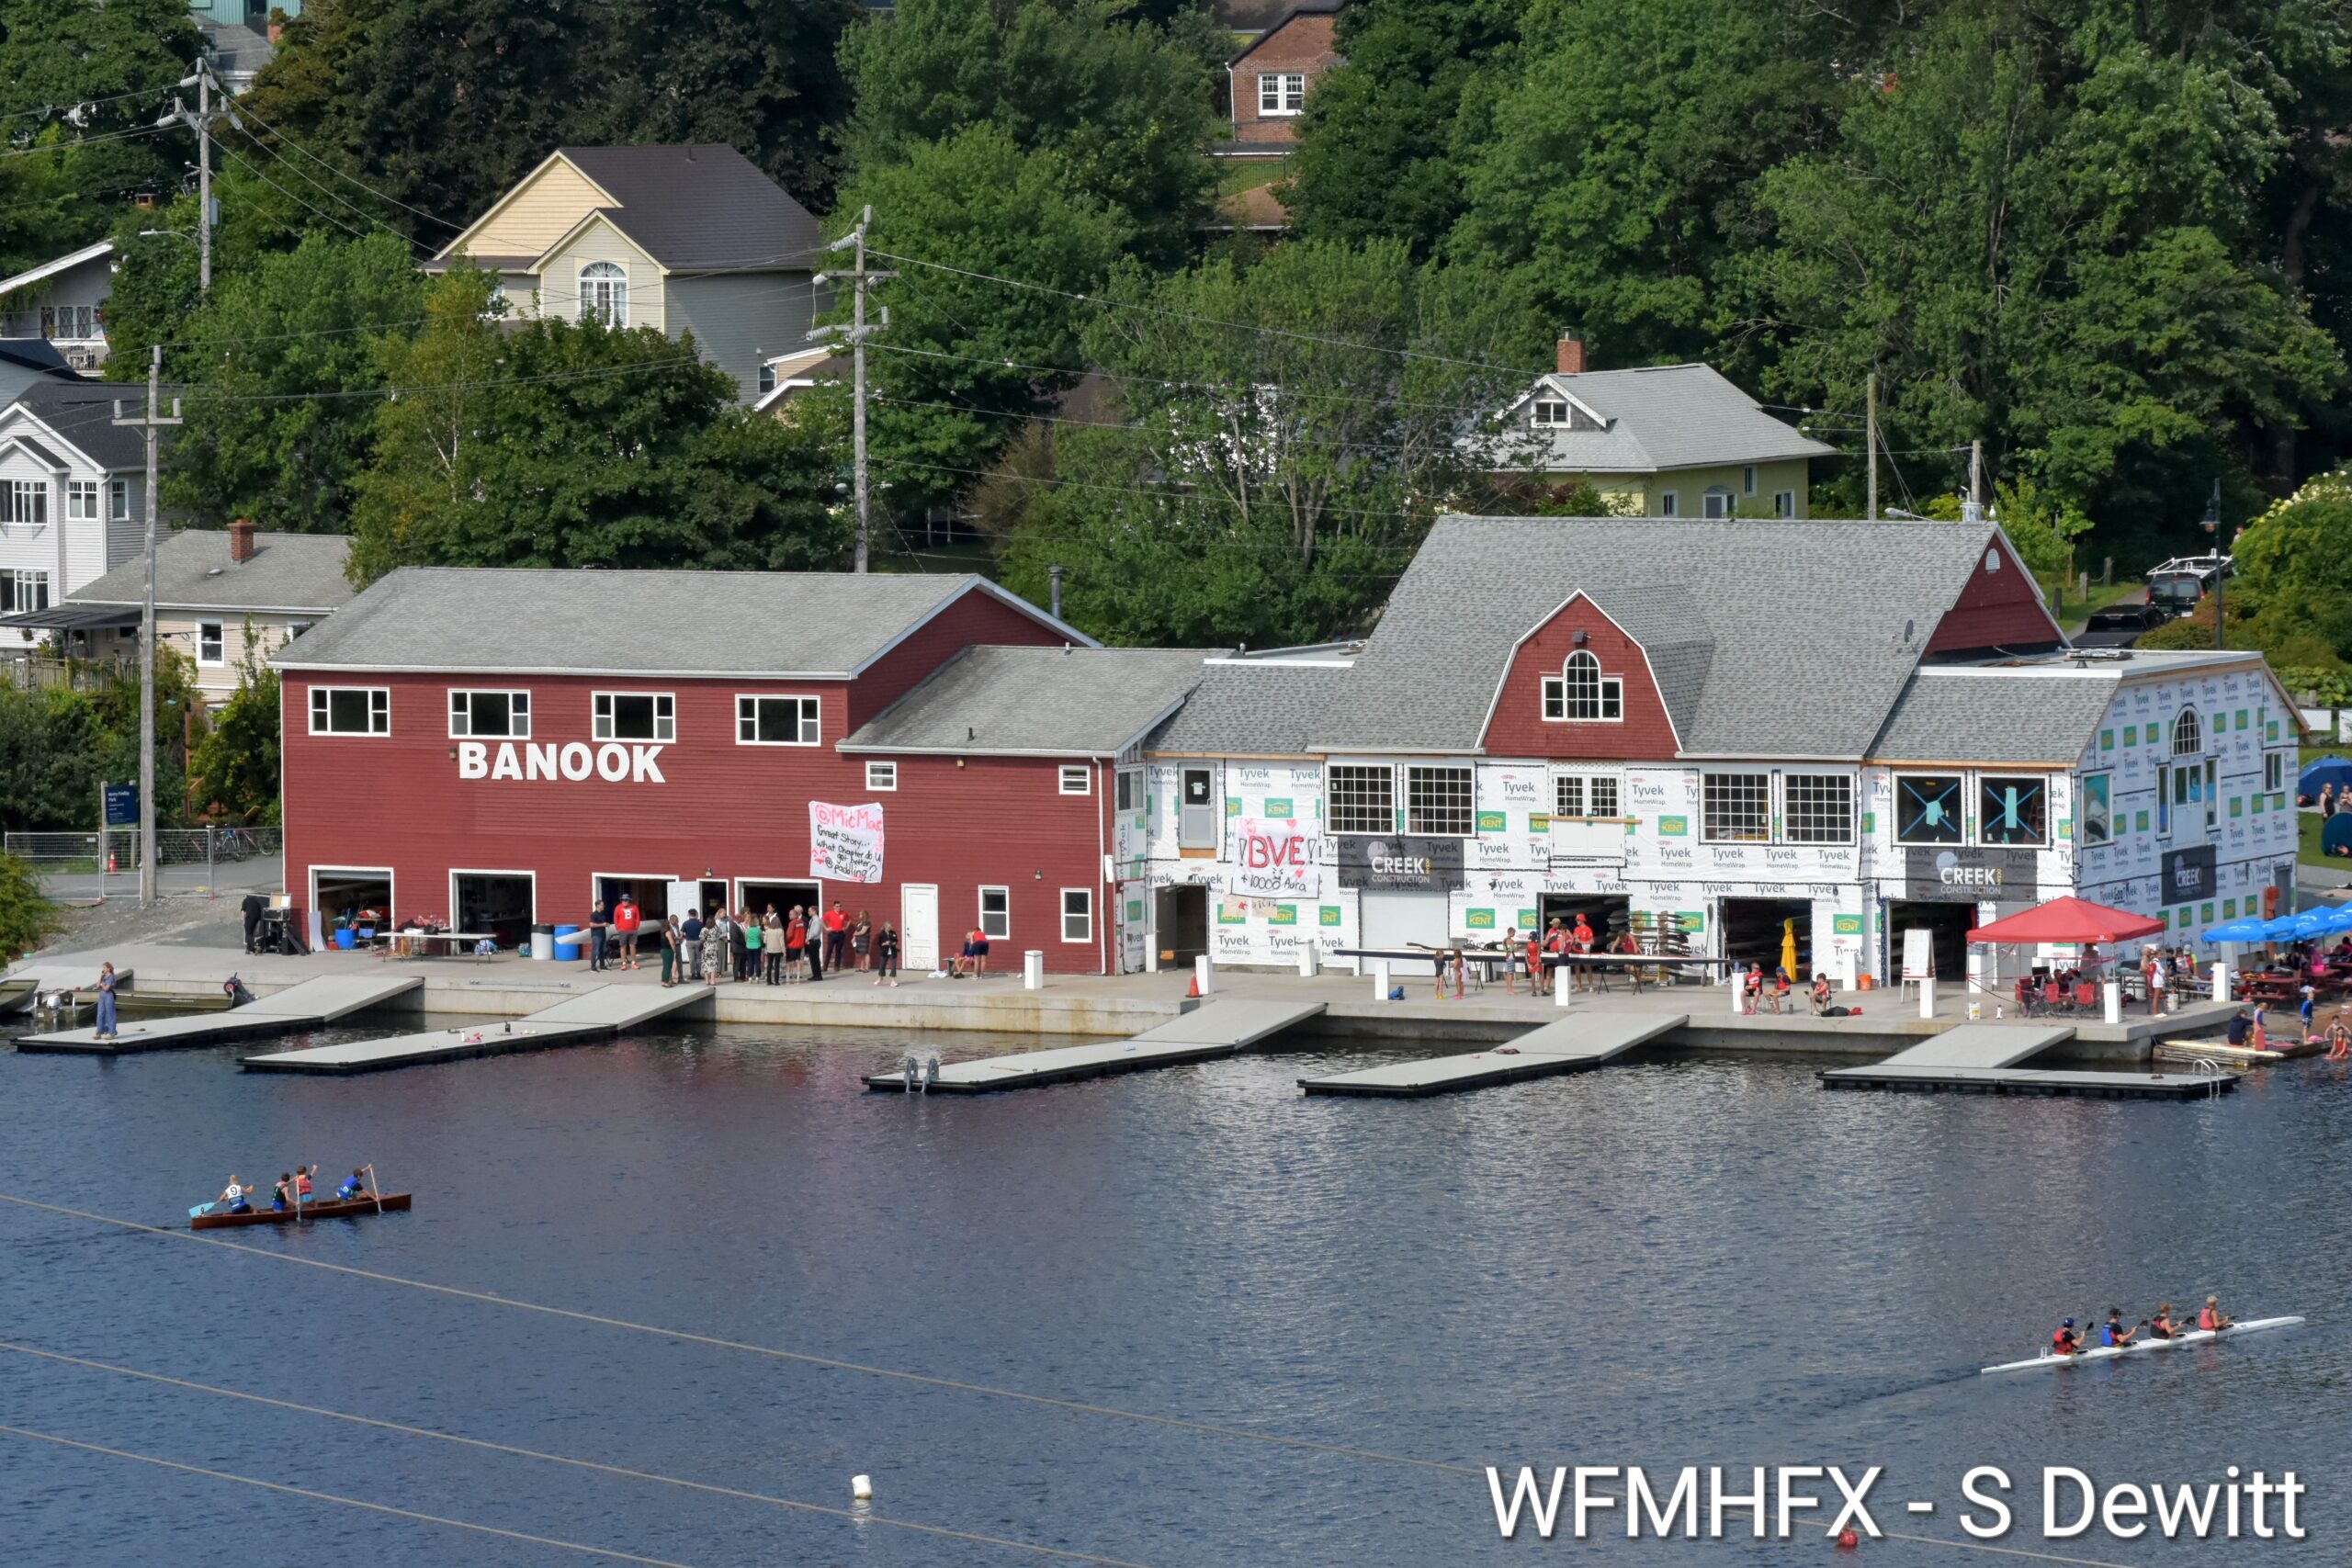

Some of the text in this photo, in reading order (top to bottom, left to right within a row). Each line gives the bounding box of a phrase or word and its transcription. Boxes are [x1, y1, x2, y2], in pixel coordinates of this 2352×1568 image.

[458, 741, 667, 784] BANOOK
[1238, 767, 1270, 780] Tyvek
[1289, 768, 1320, 781] Tyvek
[1503, 781, 1535, 795] Tyvek
[1632, 784, 1664, 797] Tyvek
[1872, 782, 1892, 795] Tyv
[1482, 819, 1501, 829] KENT
[1477, 842, 1510, 855] Tyvek
[1530, 843, 1549, 856] Tyv
[1659, 847, 1691, 860] Tyvek
[1712, 847, 1744, 861] Tyvek
[1765, 848, 1797, 862] Tyvek
[1818, 849, 1850, 863] Tyvek
[1372, 857, 1424, 874] CREEK
[1372, 874, 1430, 883] CONSTRUCTION
[1940, 867, 1996, 886] CREEK
[1284, 876, 1306, 892] Aura
[1491, 878, 1523, 891] Tyvek
[1544, 879, 1575, 892] Tyvek
[1596, 880, 1628, 894] Tyvek
[1648, 881, 1680, 894] Tyvek
[1702, 883, 1733, 896] Tyvek
[1755, 883, 1786, 897] Tyvek
[1940, 886, 2001, 895] CONSTRUCTION
[1218, 935, 1250, 948] Tyvek
[230, 1186, 238, 1196] 9
